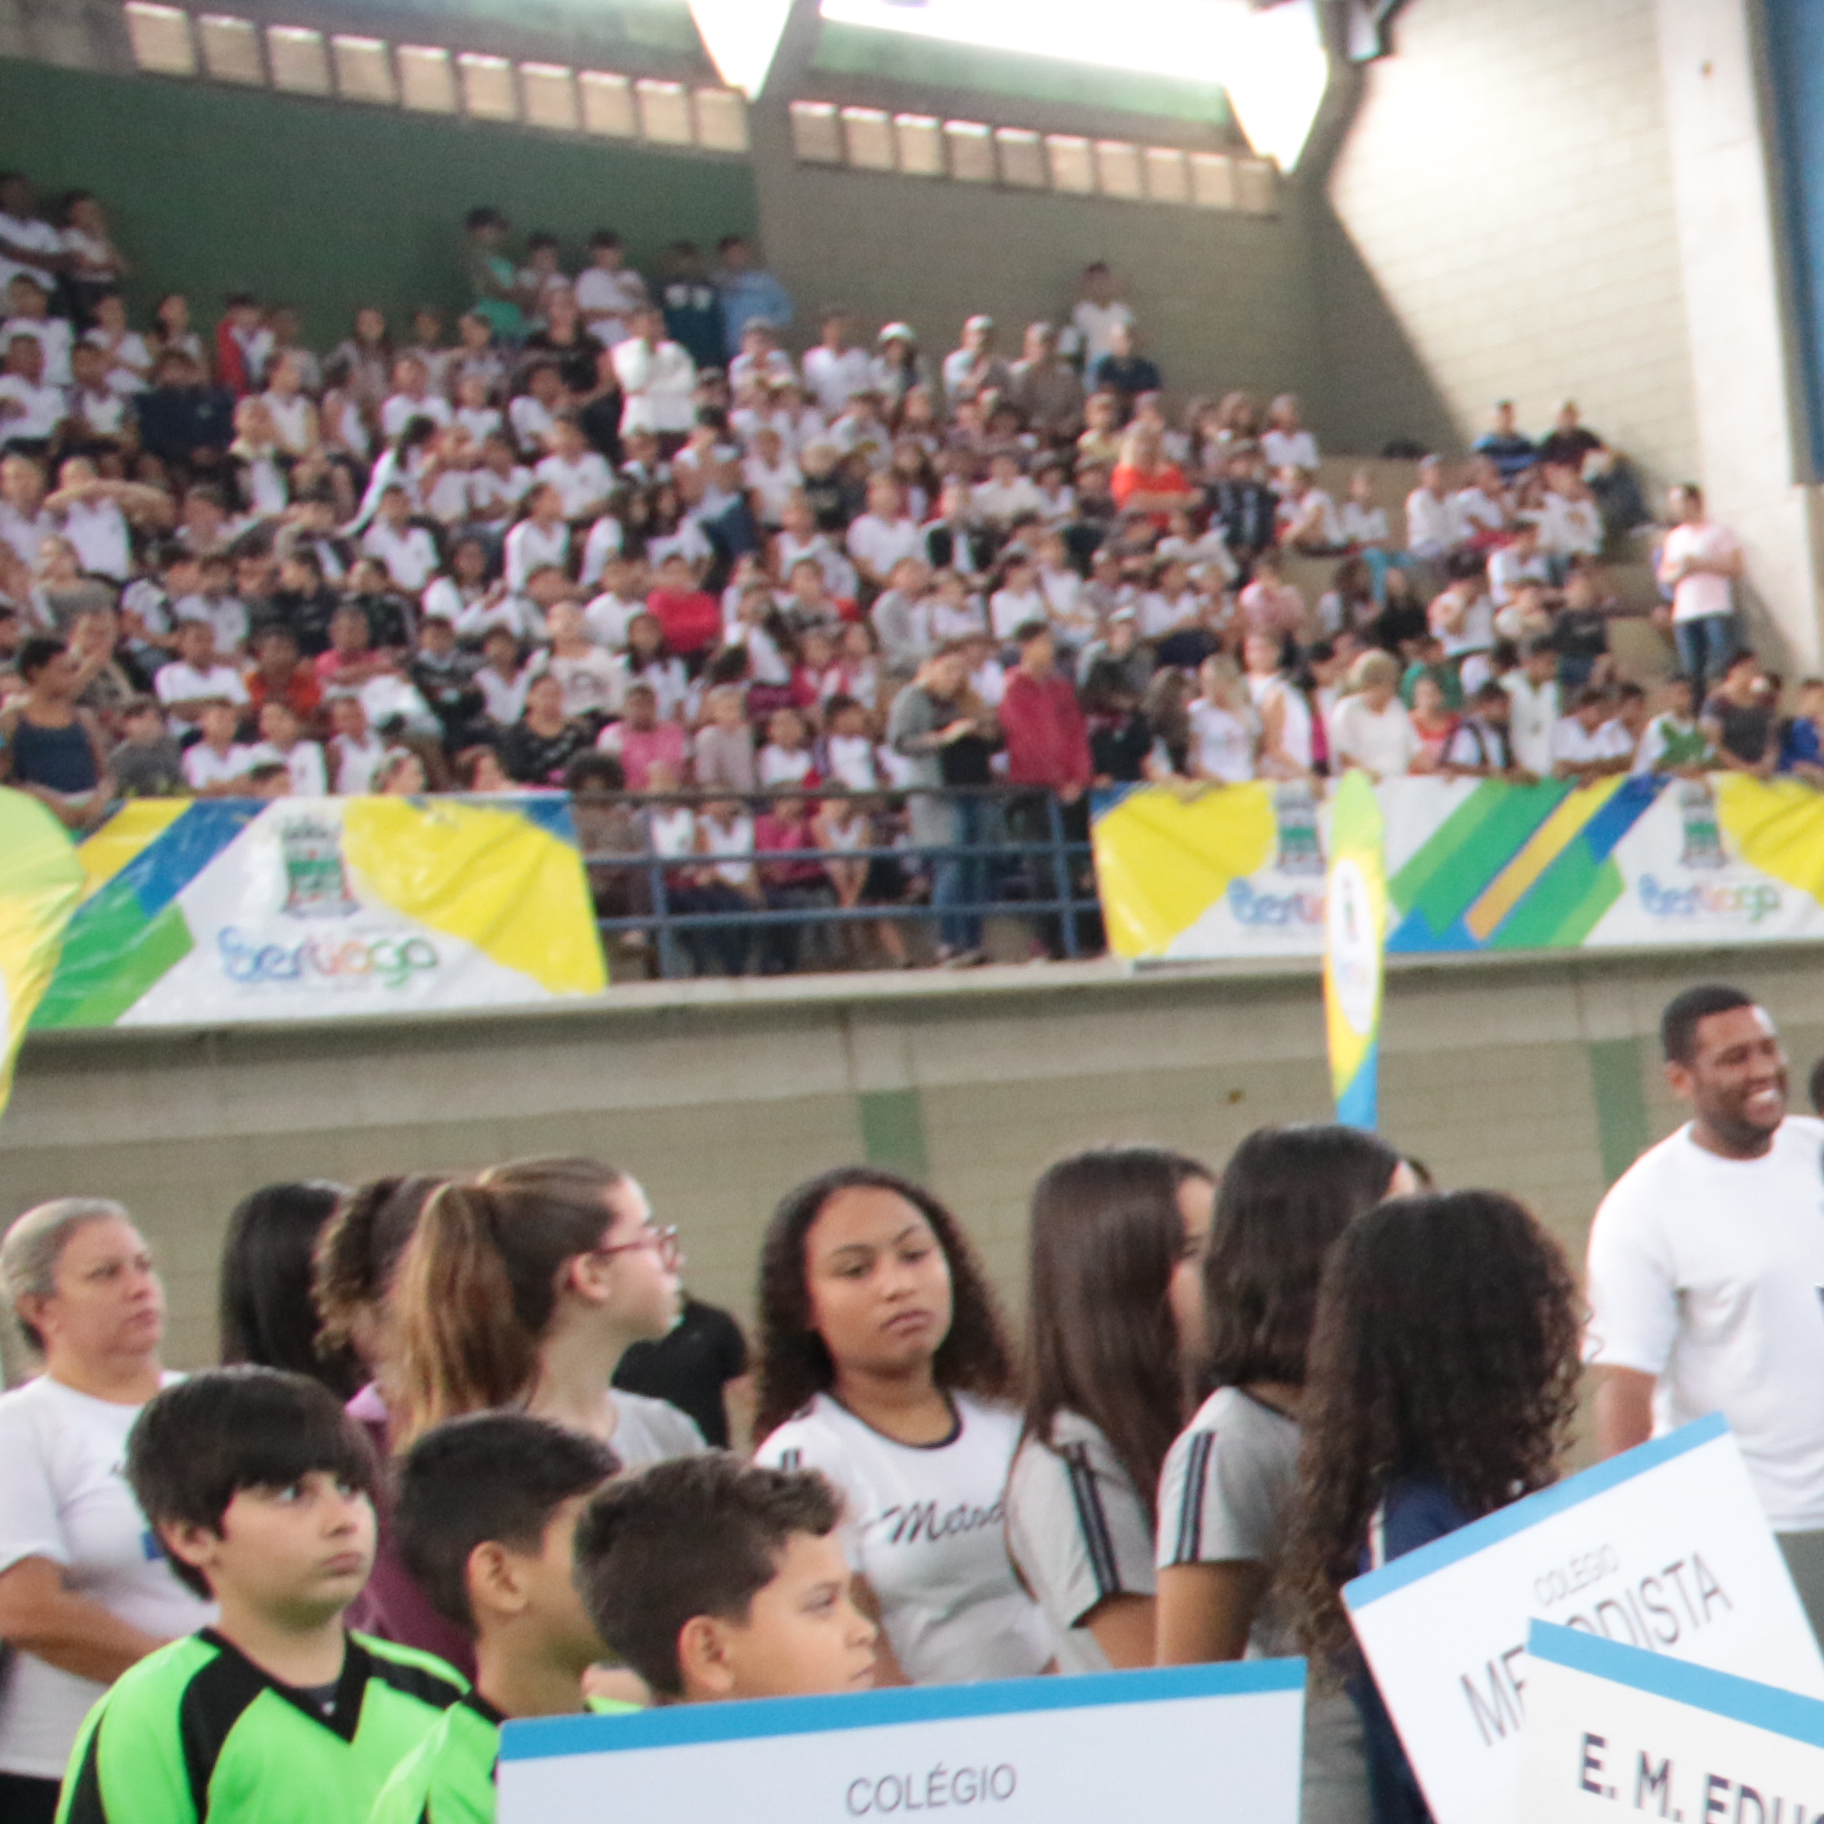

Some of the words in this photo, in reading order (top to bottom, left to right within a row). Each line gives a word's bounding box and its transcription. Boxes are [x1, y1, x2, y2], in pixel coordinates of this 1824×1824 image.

[1532, 1542, 1622, 1608] COLÉGIO
[845, 1760, 1018, 1817] COLÉGIO
[1579, 1731, 1619, 1801] E.
[1633, 1749, 1684, 1824] M.
